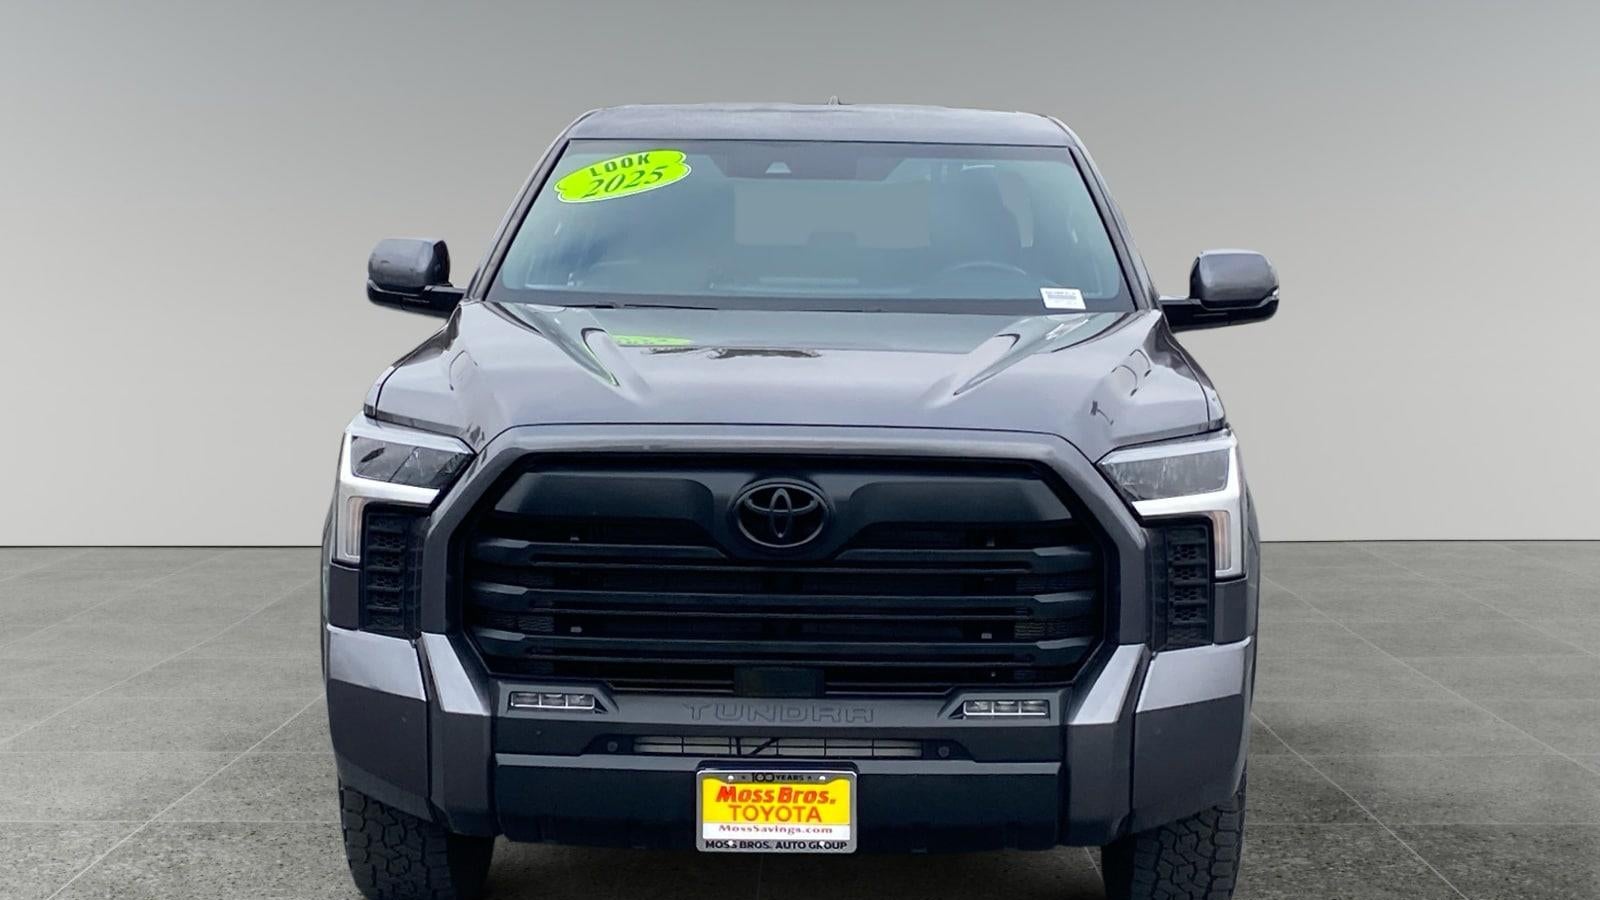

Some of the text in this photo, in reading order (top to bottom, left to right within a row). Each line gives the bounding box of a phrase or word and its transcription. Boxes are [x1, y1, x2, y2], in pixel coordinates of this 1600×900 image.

[589, 153, 651, 177] LOOK
[582, 165, 669, 198] 2025
[682, 702, 875, 723] TUNDRA
[751, 772, 804, 783] 100 YEARS
[716, 786, 836, 805] Moss Bros.
[728, 804, 823, 823] TOYOTA
[718, 824, 833, 835] MossSavings.com
[739, 840, 772, 849] BROS.
[775, 840, 807, 850] AUTO
